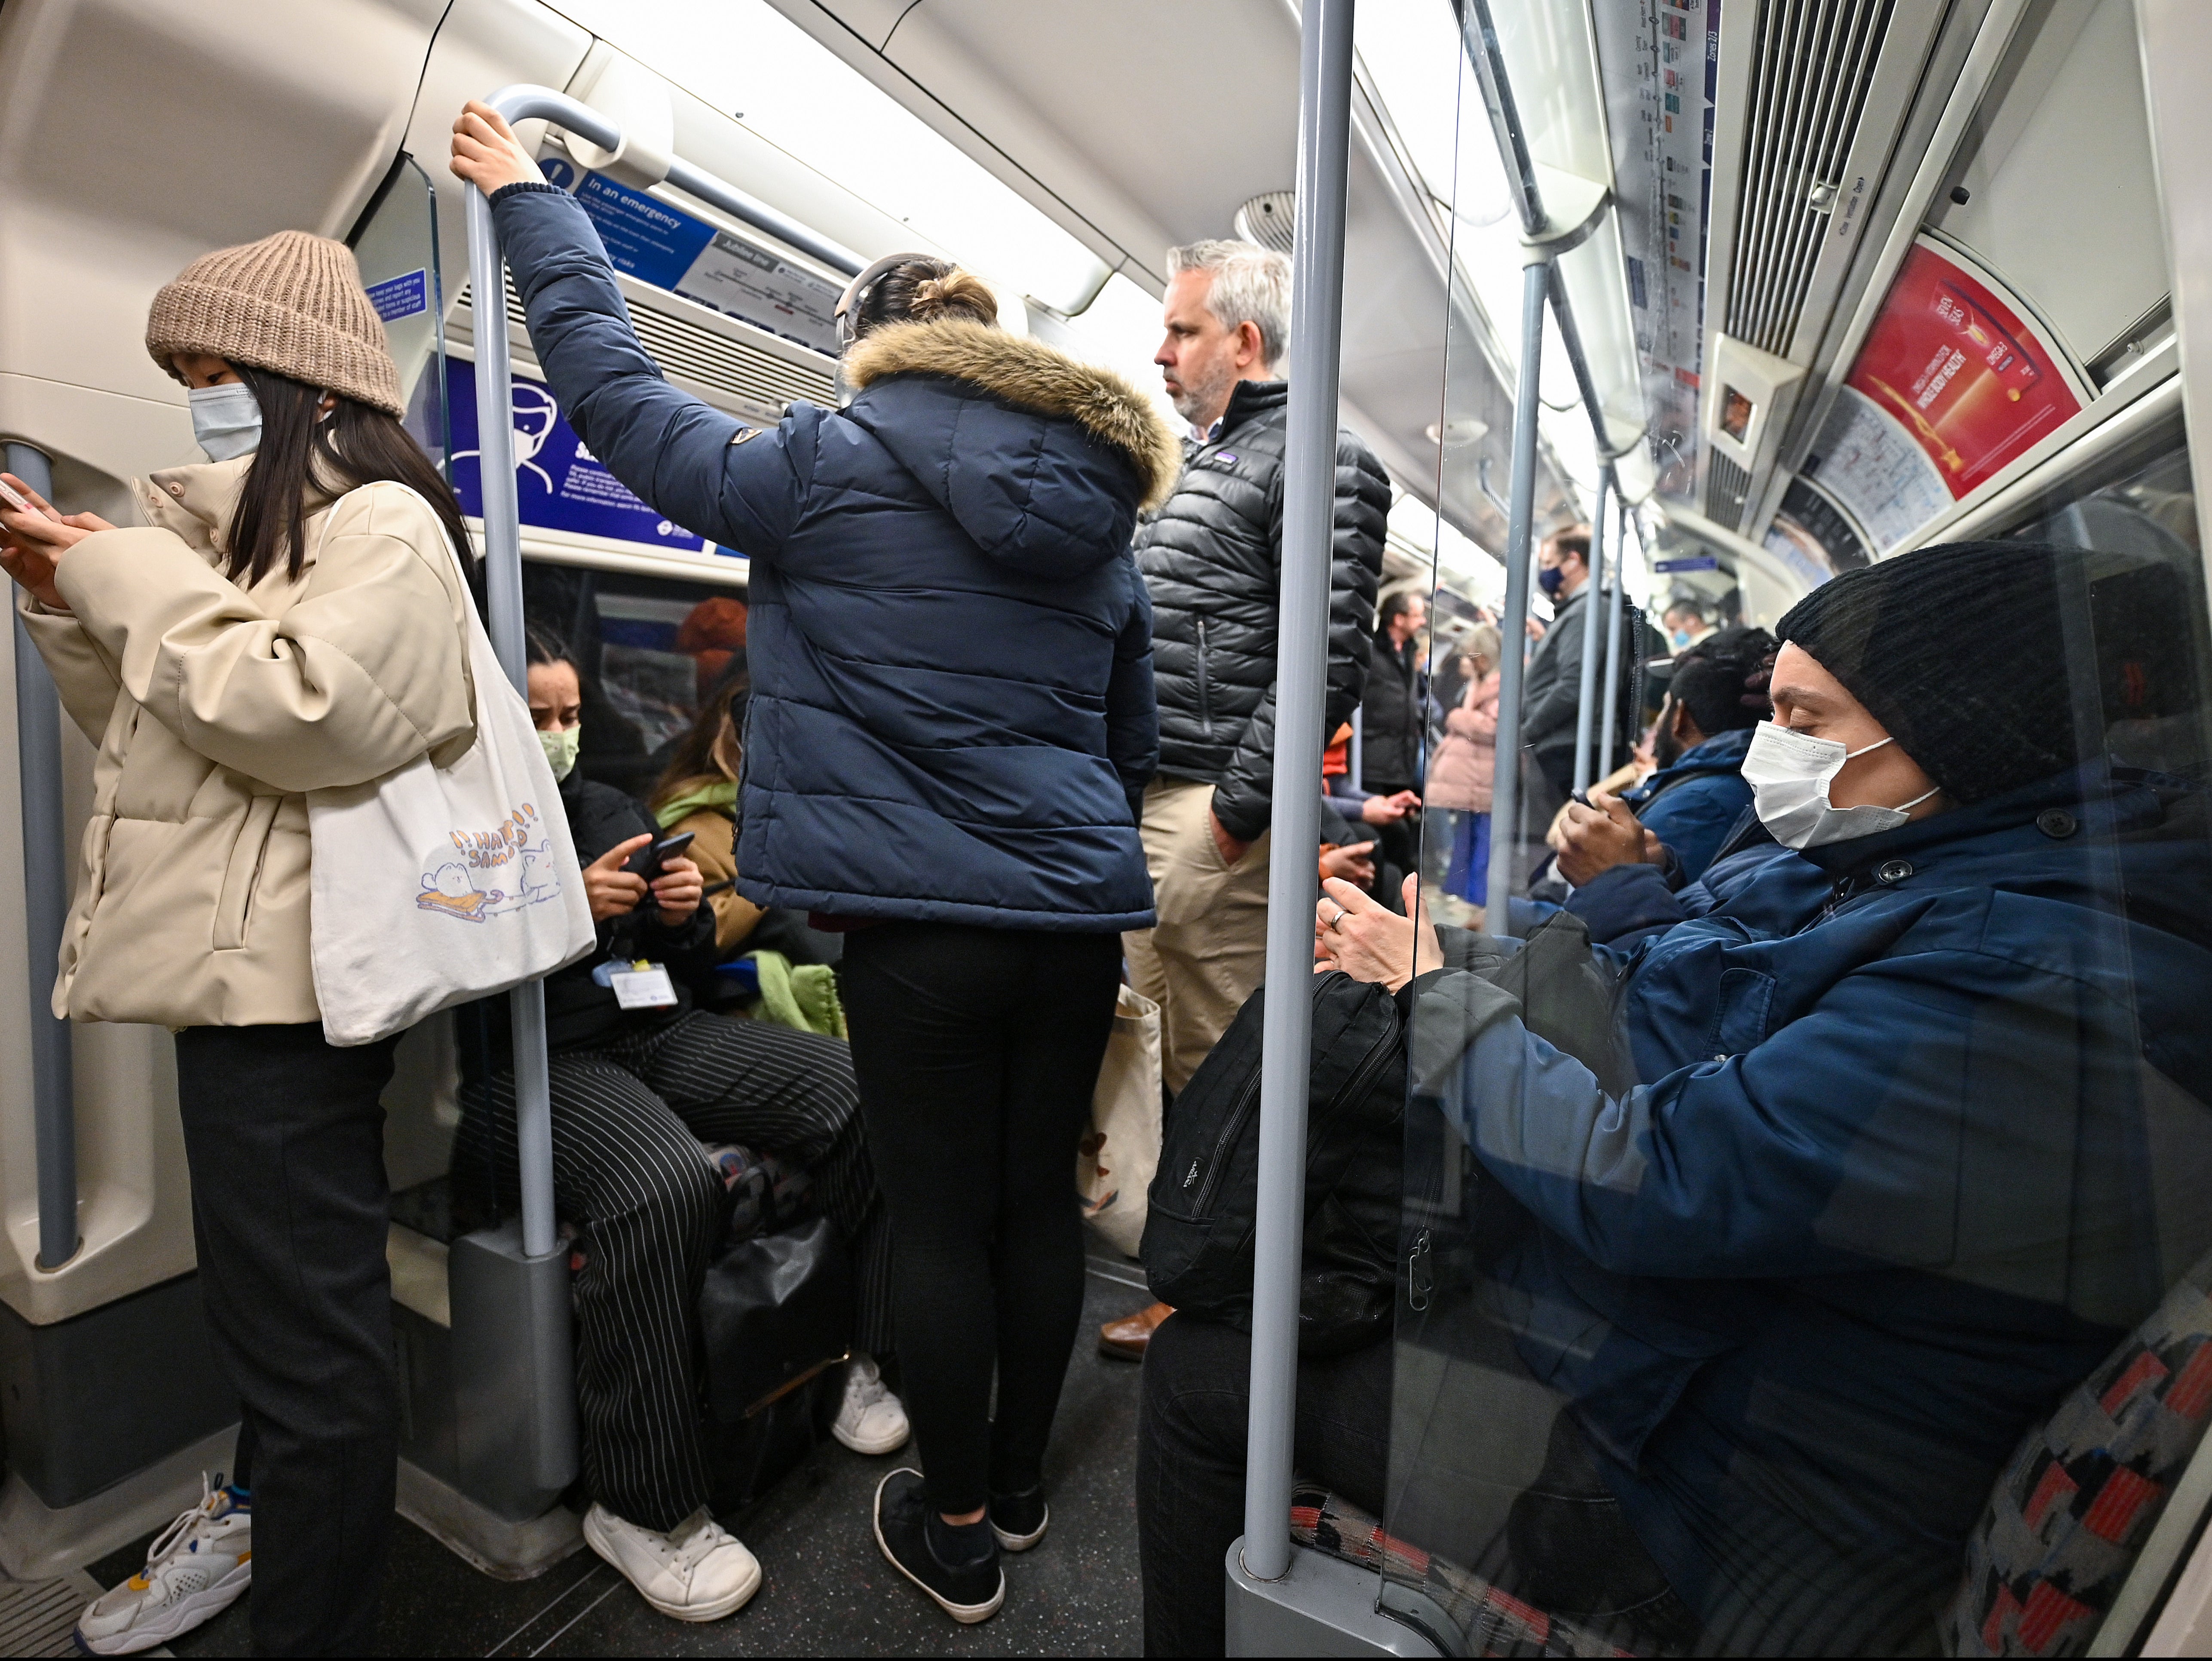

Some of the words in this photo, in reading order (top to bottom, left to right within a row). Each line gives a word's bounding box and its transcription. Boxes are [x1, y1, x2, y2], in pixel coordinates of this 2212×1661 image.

[1708, 30, 1717, 43] 2/3
[1708, 43, 1716, 62] Zones
[1853, 179, 1864, 193] Open
[588, 178, 601, 191] In
[602, 187, 619, 199] an
[620, 195, 681, 229] emergency
[617, 257, 635, 268] risks
[1937, 295, 1953, 319] SEVEN
[1949, 306, 1964, 325] SEAS
[1986, 341, 2007, 365] OMEGA-3
